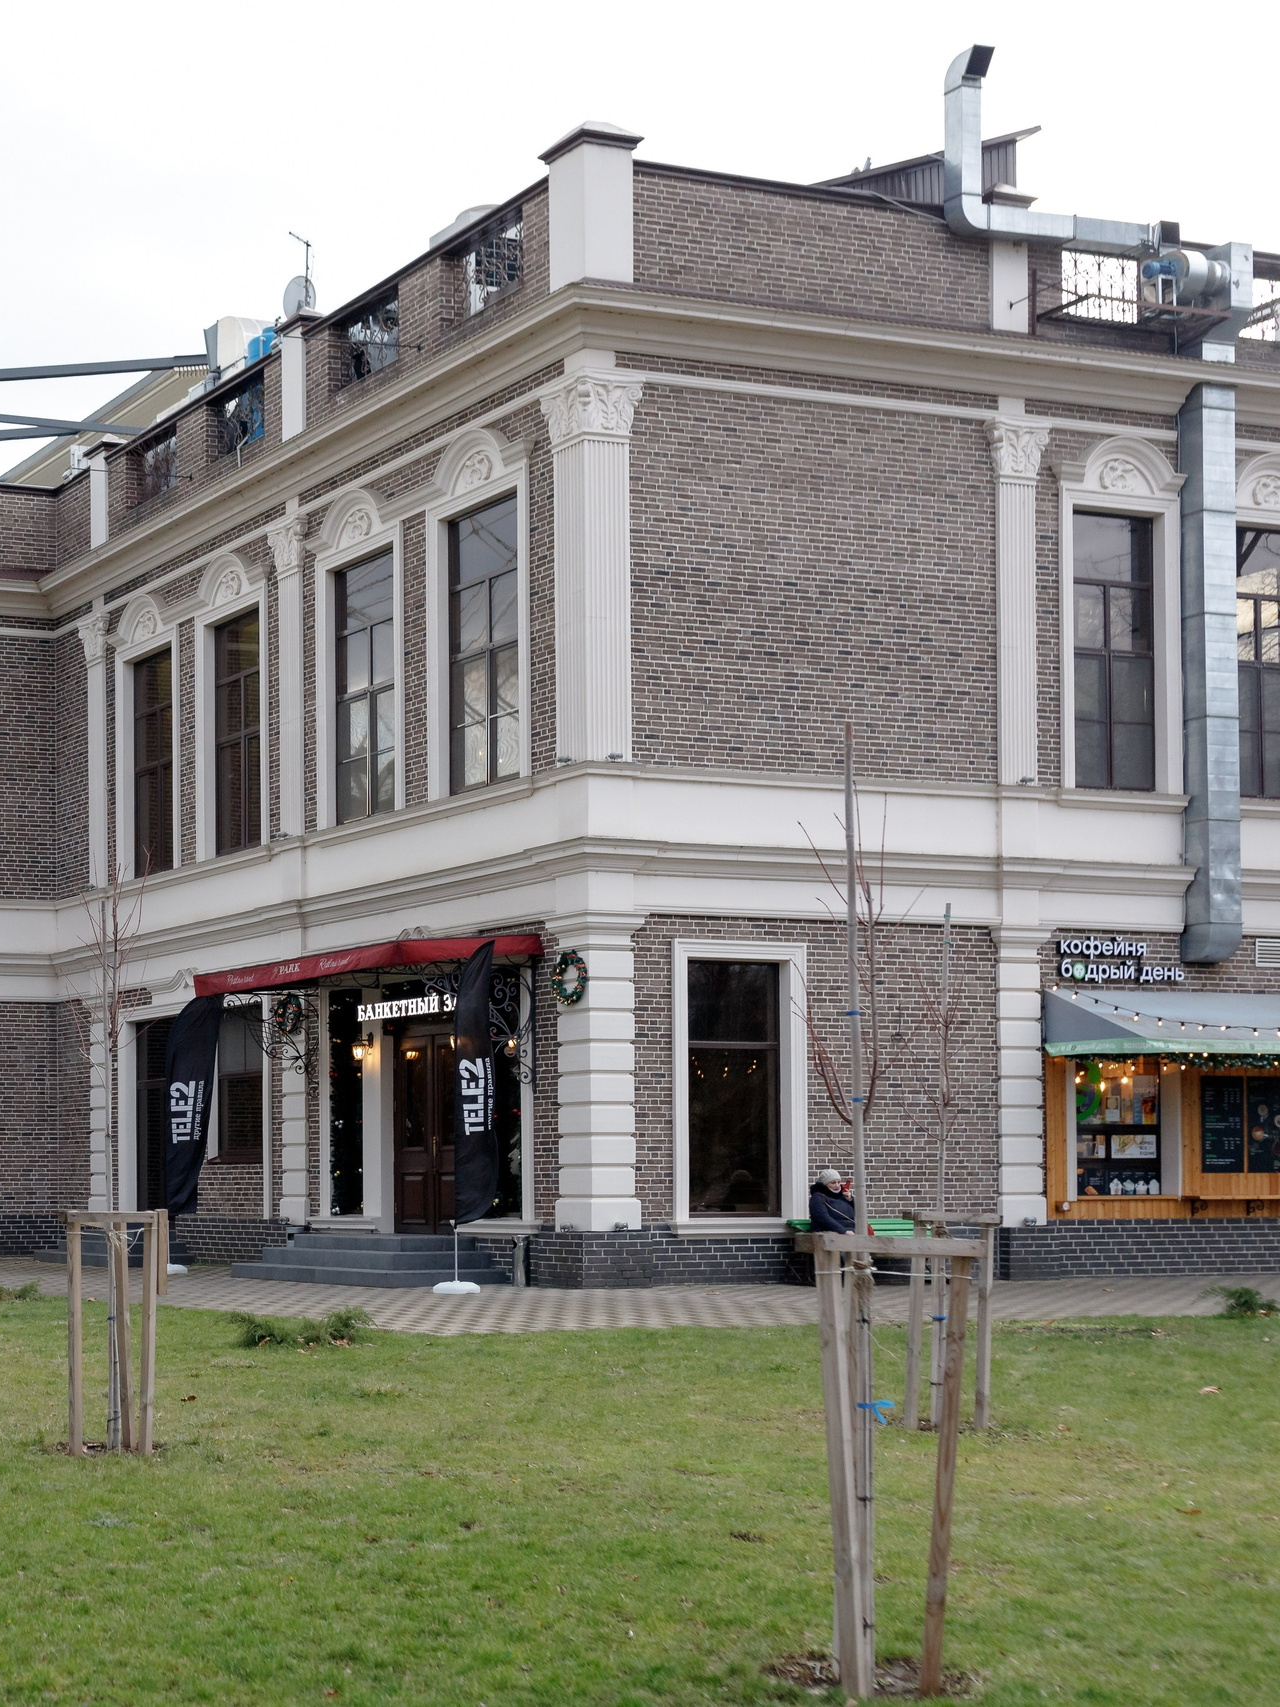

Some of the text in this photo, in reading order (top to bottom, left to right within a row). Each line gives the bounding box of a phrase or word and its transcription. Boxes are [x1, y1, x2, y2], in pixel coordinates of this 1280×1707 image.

[1060, 936, 1147, 959] кофейня
[278, 962, 301, 976] PARK
[1061, 959, 1185, 983] бодрый день
[357, 992, 440, 1022] БАНКЕТНЫЙ
[485, 1057, 494, 1096] правила
[169, 1080, 196, 1144] TELE2
[193, 1080, 205, 1141] другие правила
[459, 1057, 485, 1136] TELE2
